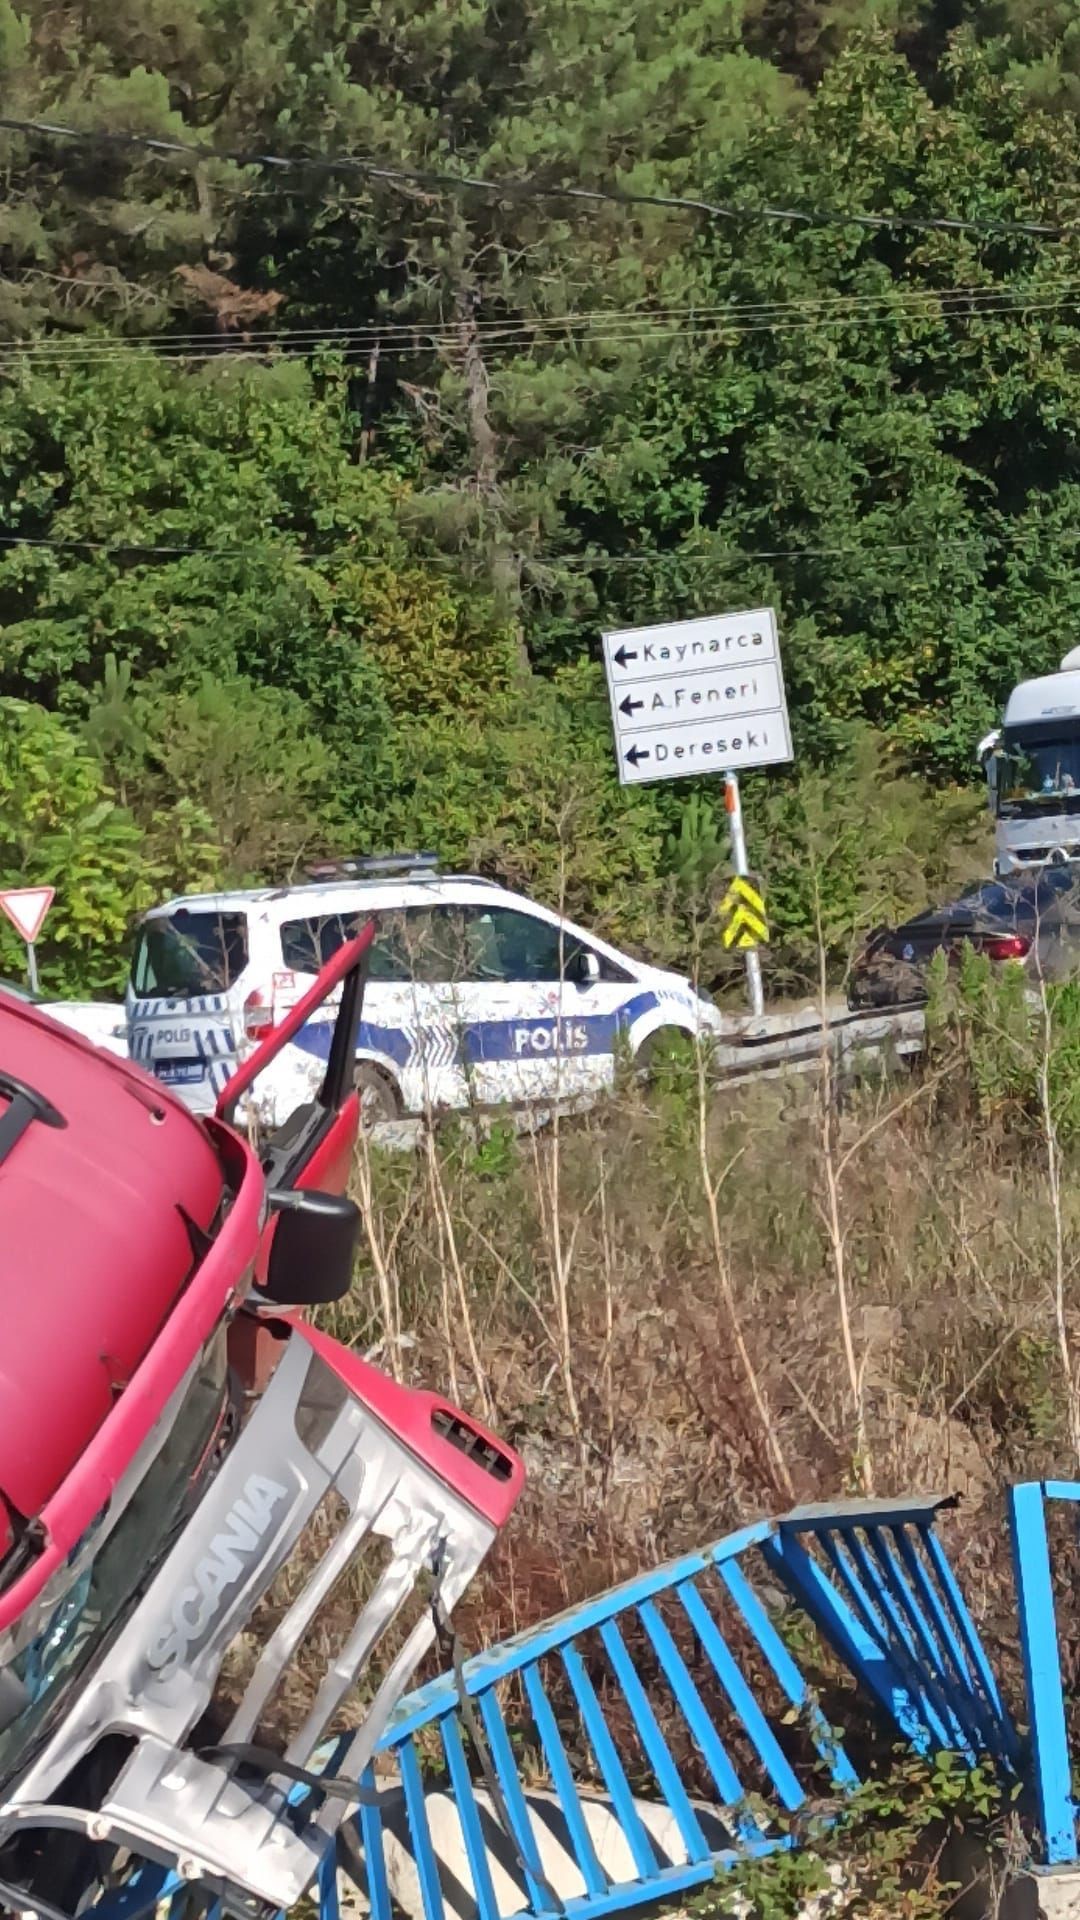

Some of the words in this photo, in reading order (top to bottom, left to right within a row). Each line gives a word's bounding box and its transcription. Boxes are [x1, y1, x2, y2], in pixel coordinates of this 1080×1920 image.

[643, 632, 763, 662] Kaynarca
[651, 678, 758, 711] A.Feneri
[655, 730, 768, 762] Dereseki
[147, 1474, 289, 1682] SCANIA
